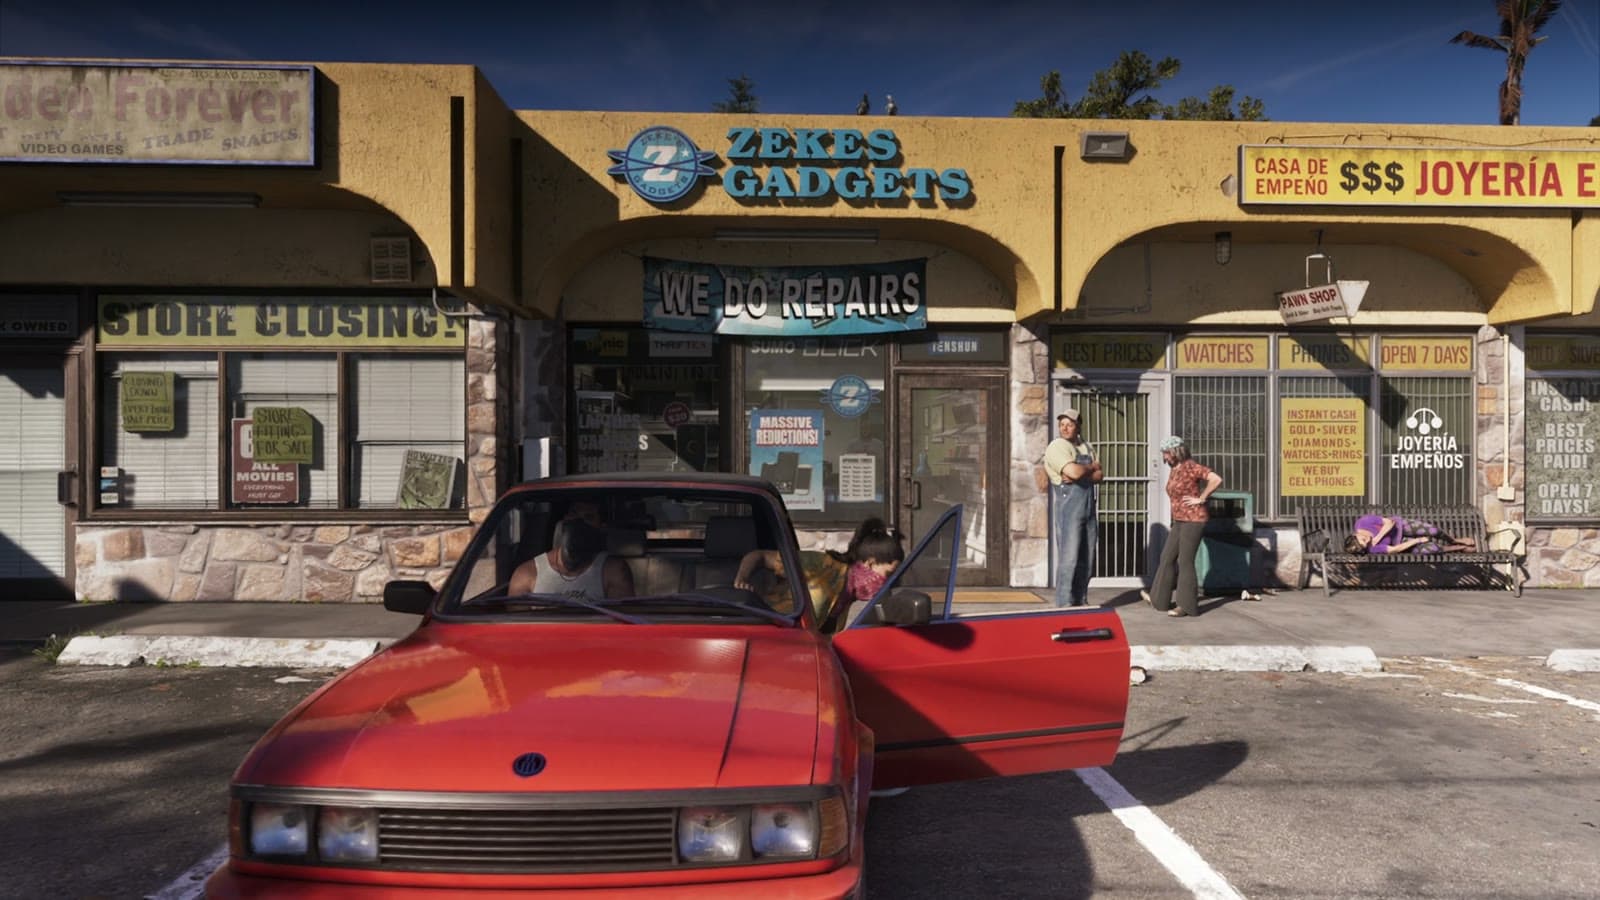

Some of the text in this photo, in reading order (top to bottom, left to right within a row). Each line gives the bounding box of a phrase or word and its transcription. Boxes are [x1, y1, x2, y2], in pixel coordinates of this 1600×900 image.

[114, 75, 299, 124] Forever
[142, 128, 215, 150] TRADE
[221, 128, 299, 151] SNACKS
[726, 127, 898, 161] ZEKES
[21, 143, 125, 155] VIDEO GAMES
[1255, 158, 1329, 176] CASA DE
[721, 165, 972, 200] GADGETS
[1339, 159, 1405, 195] $$$
[1416, 155, 1597, 198] JOYERÍA E
[660, 271, 921, 319] WE DO REPAIRS
[1280, 288, 1337, 309] PAWN SHOP
[102, 302, 459, 339] STORE CLOSING!
[1063, 342, 1153, 362] BEST PRICES
[1183, 343, 1255, 363] WATCHES
[1291, 344, 1350, 364] PHONES
[1381, 345, 1468, 364] OPEN 7 DAYS
[1540, 396, 1591, 412] CASH!
[760, 416, 813, 429] MASSIVE
[1288, 409, 1357, 419] INSTANT CASH
[756, 429, 819, 446] REDUCTIONS!
[1289, 425, 1357, 435] GOLD SILVER
[1545, 423, 1586, 437] BEST
[1292, 438, 1351, 448] DIAMONDS
[1397, 432, 1458, 451] JOYERÍA
[1536, 439, 1595, 453] PRICES
[251, 462, 280, 471] ALL
[1391, 451, 1464, 469] EMPEÑOS
[1543, 454, 1588, 469] PAID!
[236, 471, 295, 482] MOVIES
[1302, 465, 1341, 475] WE BUY
[1289, 476, 1355, 487] CELL PHONES
[1538, 483, 1593, 498] OPEN 7
[1541, 499, 1590, 514] DAYS!
